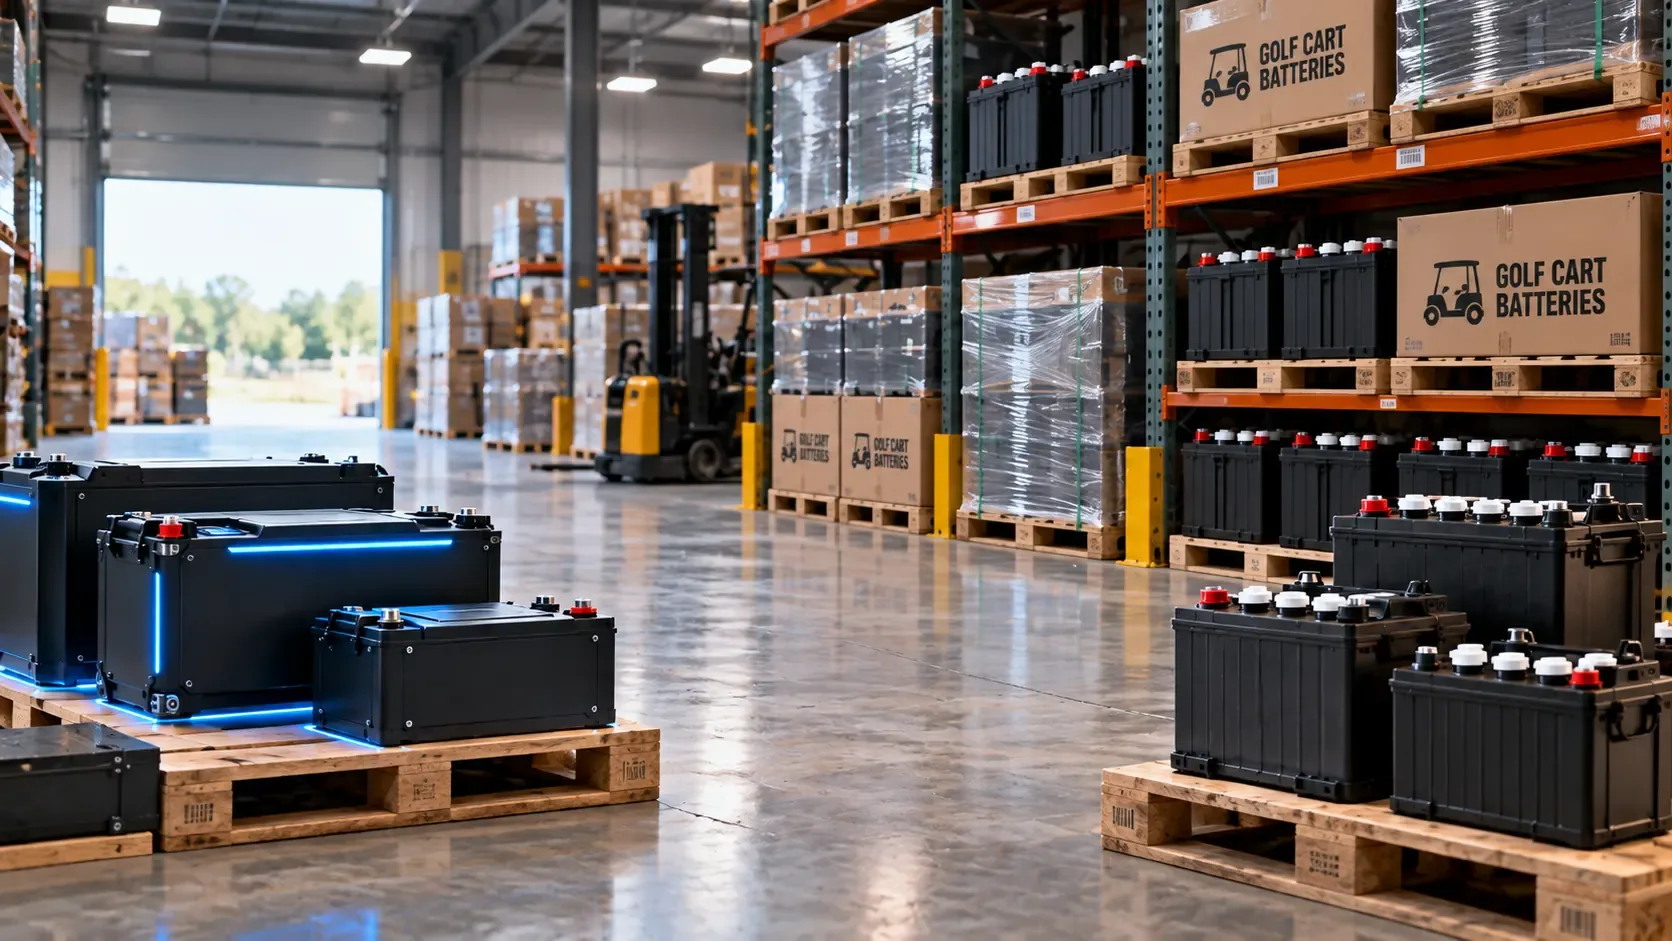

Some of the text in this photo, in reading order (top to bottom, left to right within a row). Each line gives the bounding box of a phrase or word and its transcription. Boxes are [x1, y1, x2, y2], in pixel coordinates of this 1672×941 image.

[1260, 24, 1346, 65] GOLF CART
[1260, 52, 1345, 91] BATTERIES
[1496, 257, 1607, 288] GOLF CART
[1496, 288, 1605, 317] BATTERIES
[874, 437, 909, 453] GOLF CART
[874, 453, 909, 470] BATTERIES
